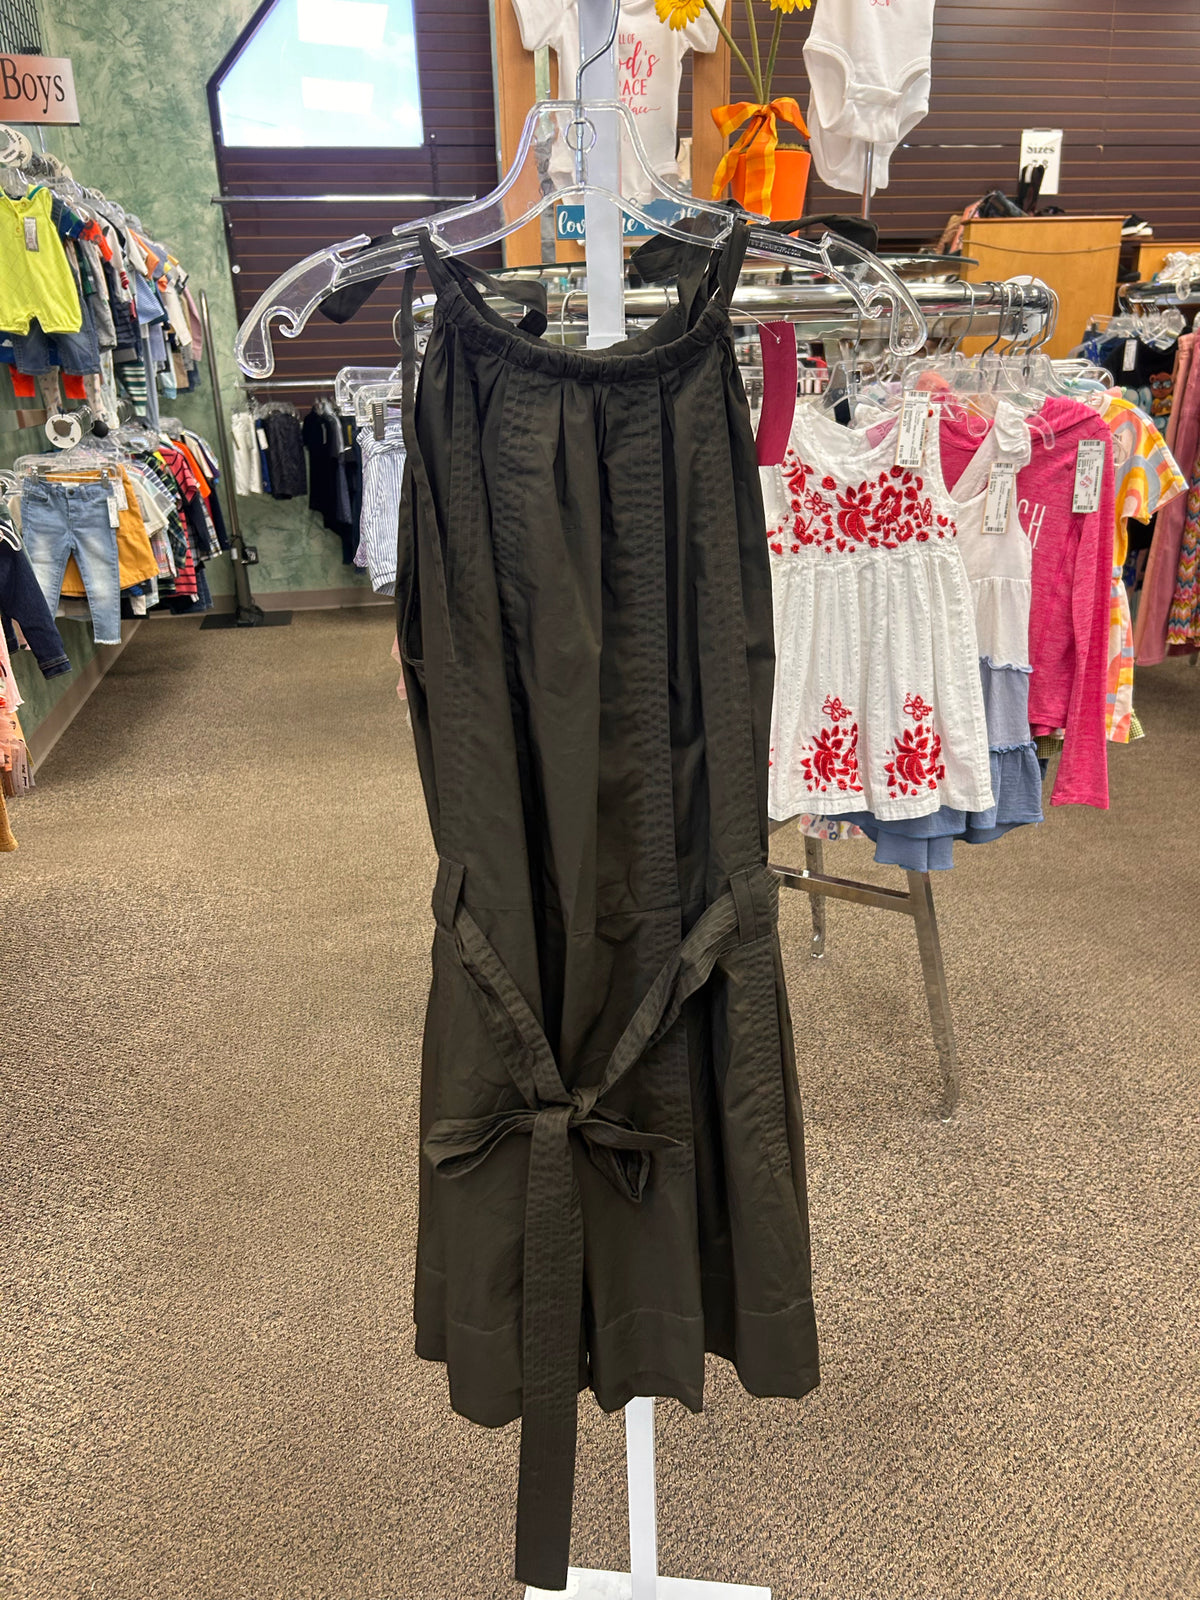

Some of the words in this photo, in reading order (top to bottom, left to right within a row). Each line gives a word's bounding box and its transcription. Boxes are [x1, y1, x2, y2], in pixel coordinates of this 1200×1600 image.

[0, 57, 65, 114] Boys
[618, 79, 648, 96] ACE
[558, 210, 586, 235] lov
